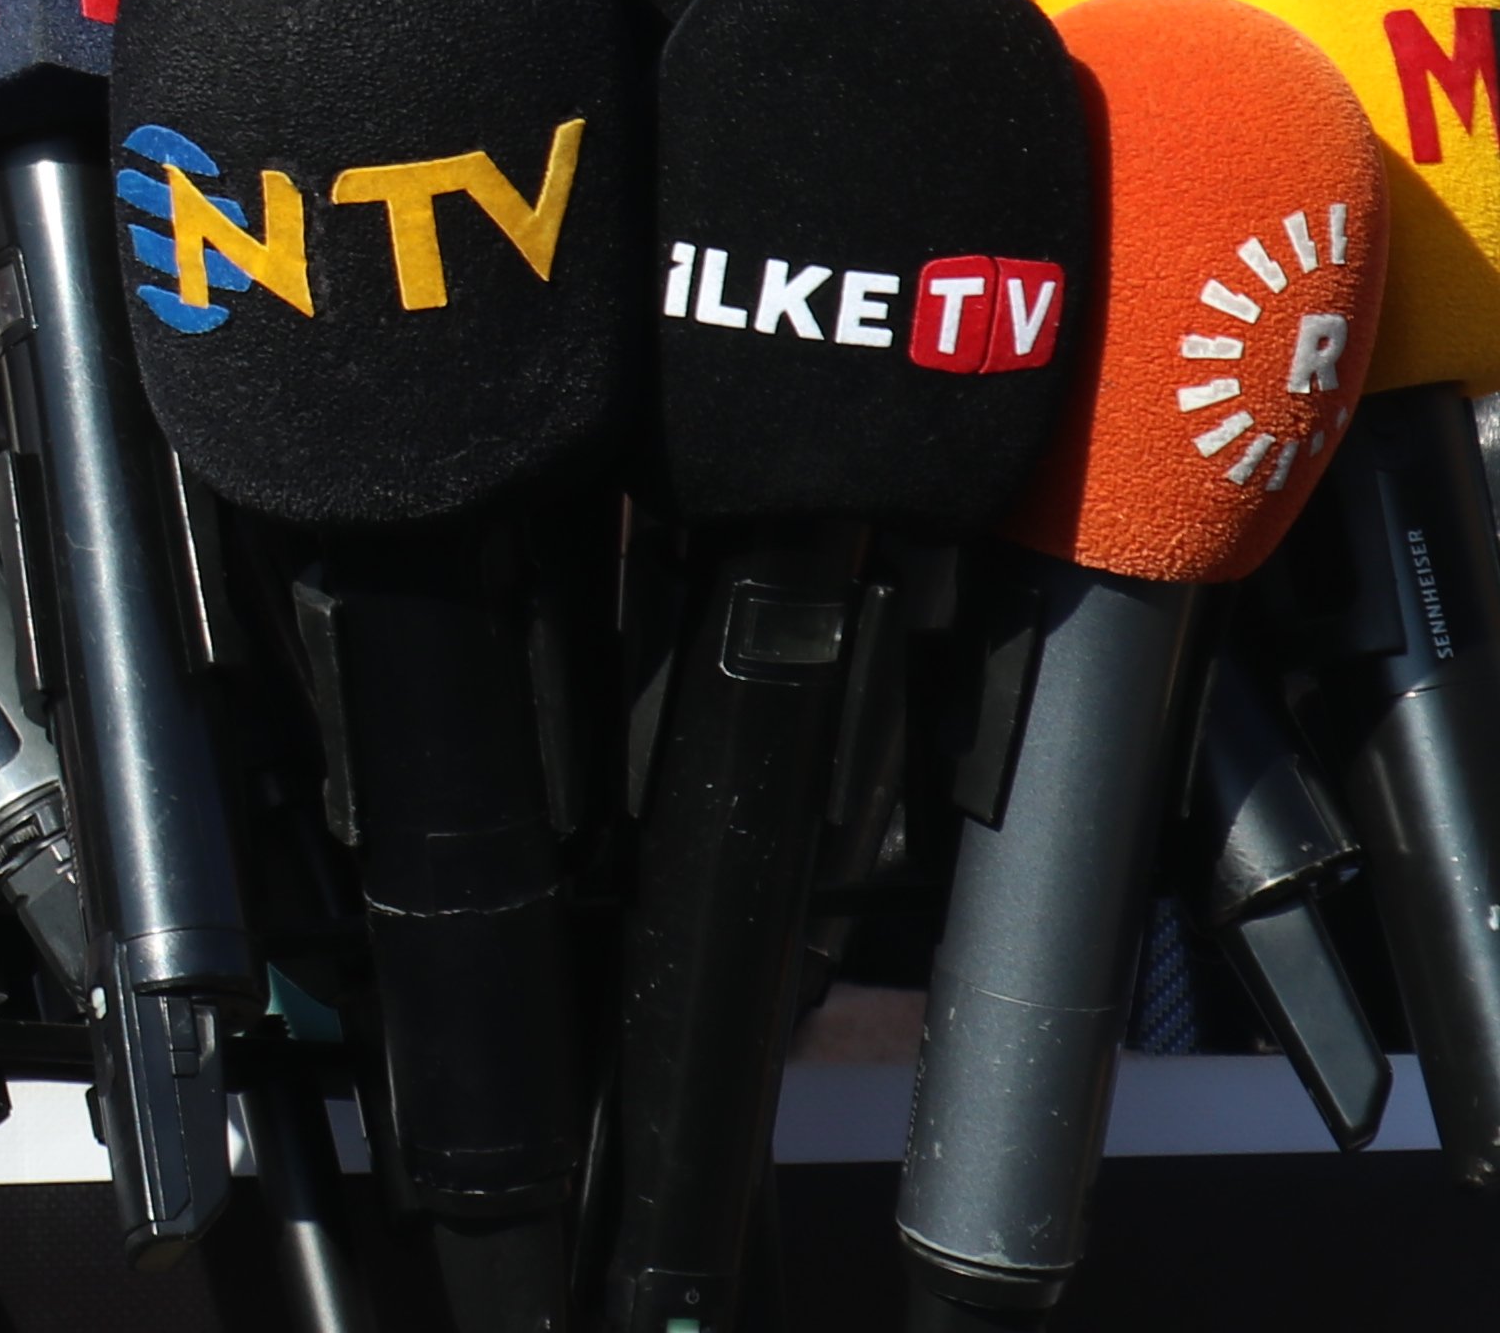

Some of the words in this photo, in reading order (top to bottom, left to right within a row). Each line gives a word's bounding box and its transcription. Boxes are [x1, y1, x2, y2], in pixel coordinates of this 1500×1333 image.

[162, 118, 587, 318] NTV
[929, 276, 1057, 356] TV
[1287, 313, 1349, 394] R
[1407, 529, 1455, 660] SENNHEISER
